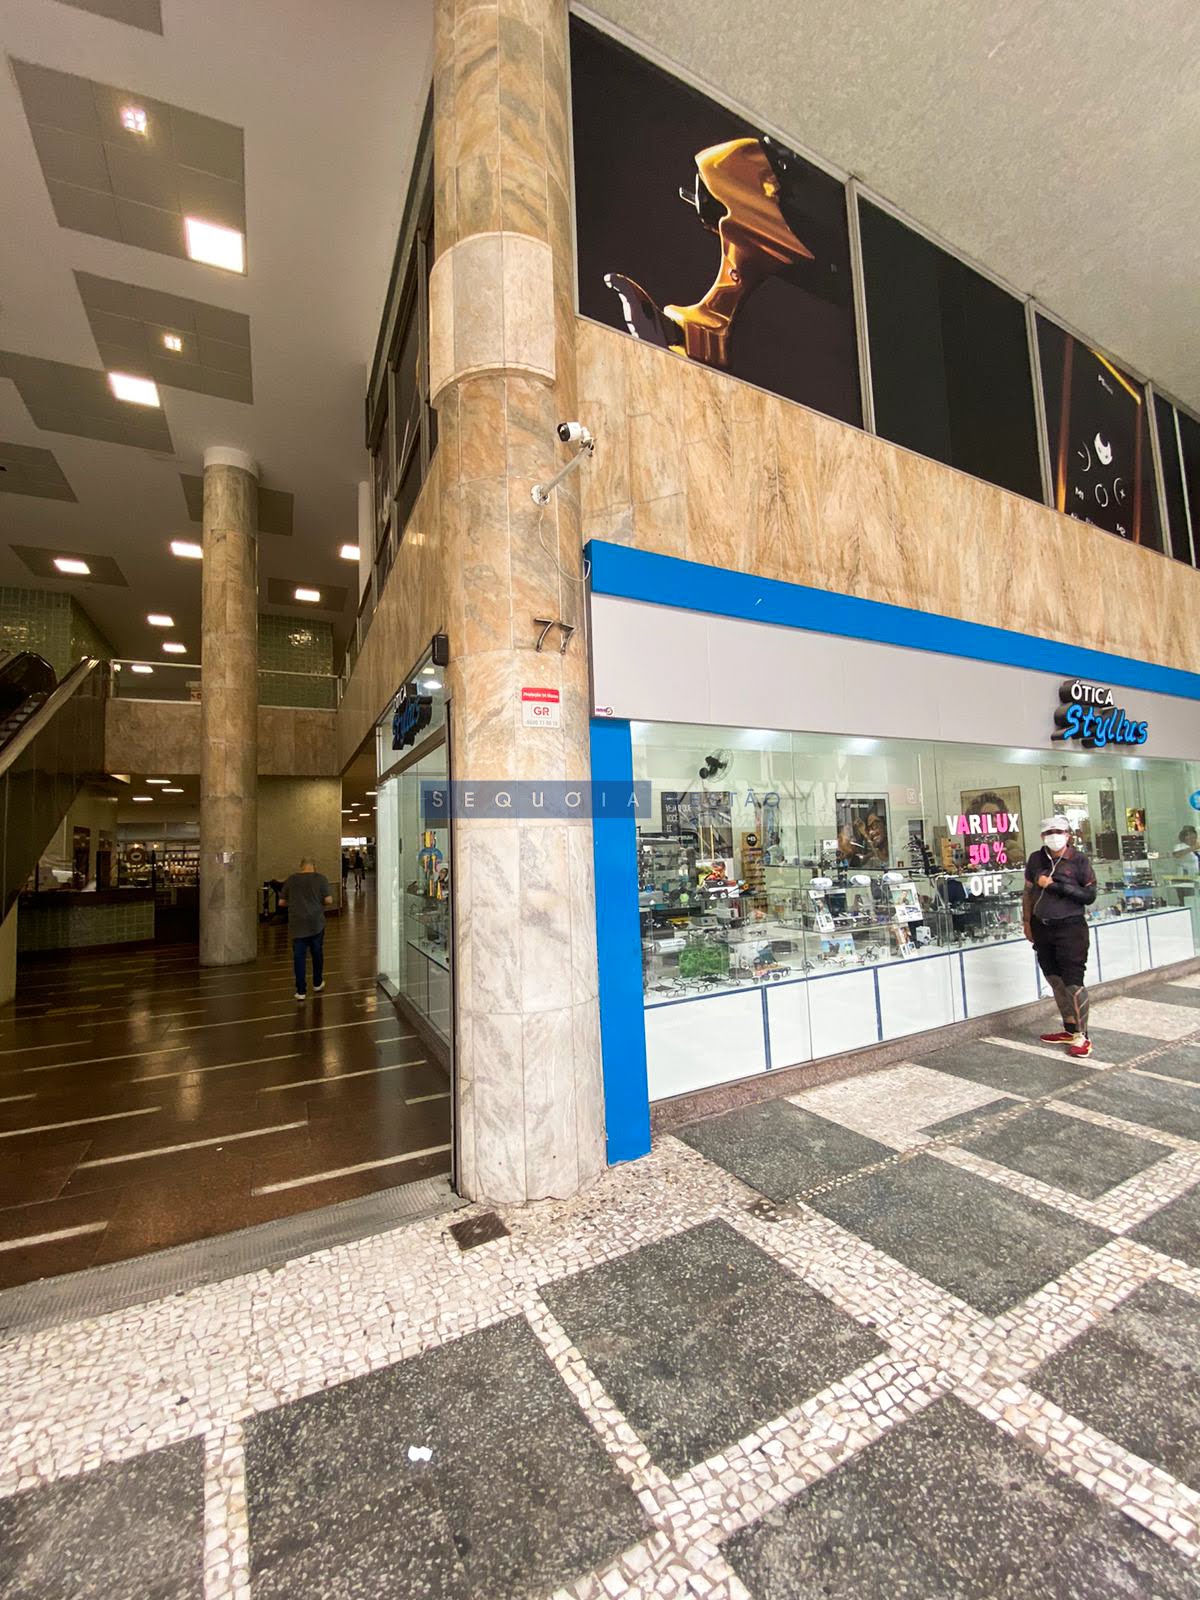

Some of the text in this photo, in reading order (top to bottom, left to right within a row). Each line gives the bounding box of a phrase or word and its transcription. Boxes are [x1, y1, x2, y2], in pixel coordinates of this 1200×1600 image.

[533, 617, 577, 656] 77
[1070, 680, 1114, 706] ÓTICA
[533, 706, 550, 717] GR
[1063, 703, 1149, 748] Styllus
[945, 812, 1020, 836] VARILUX
[968, 840, 1008, 866] 50 %
[969, 874, 1003, 898] OFF
